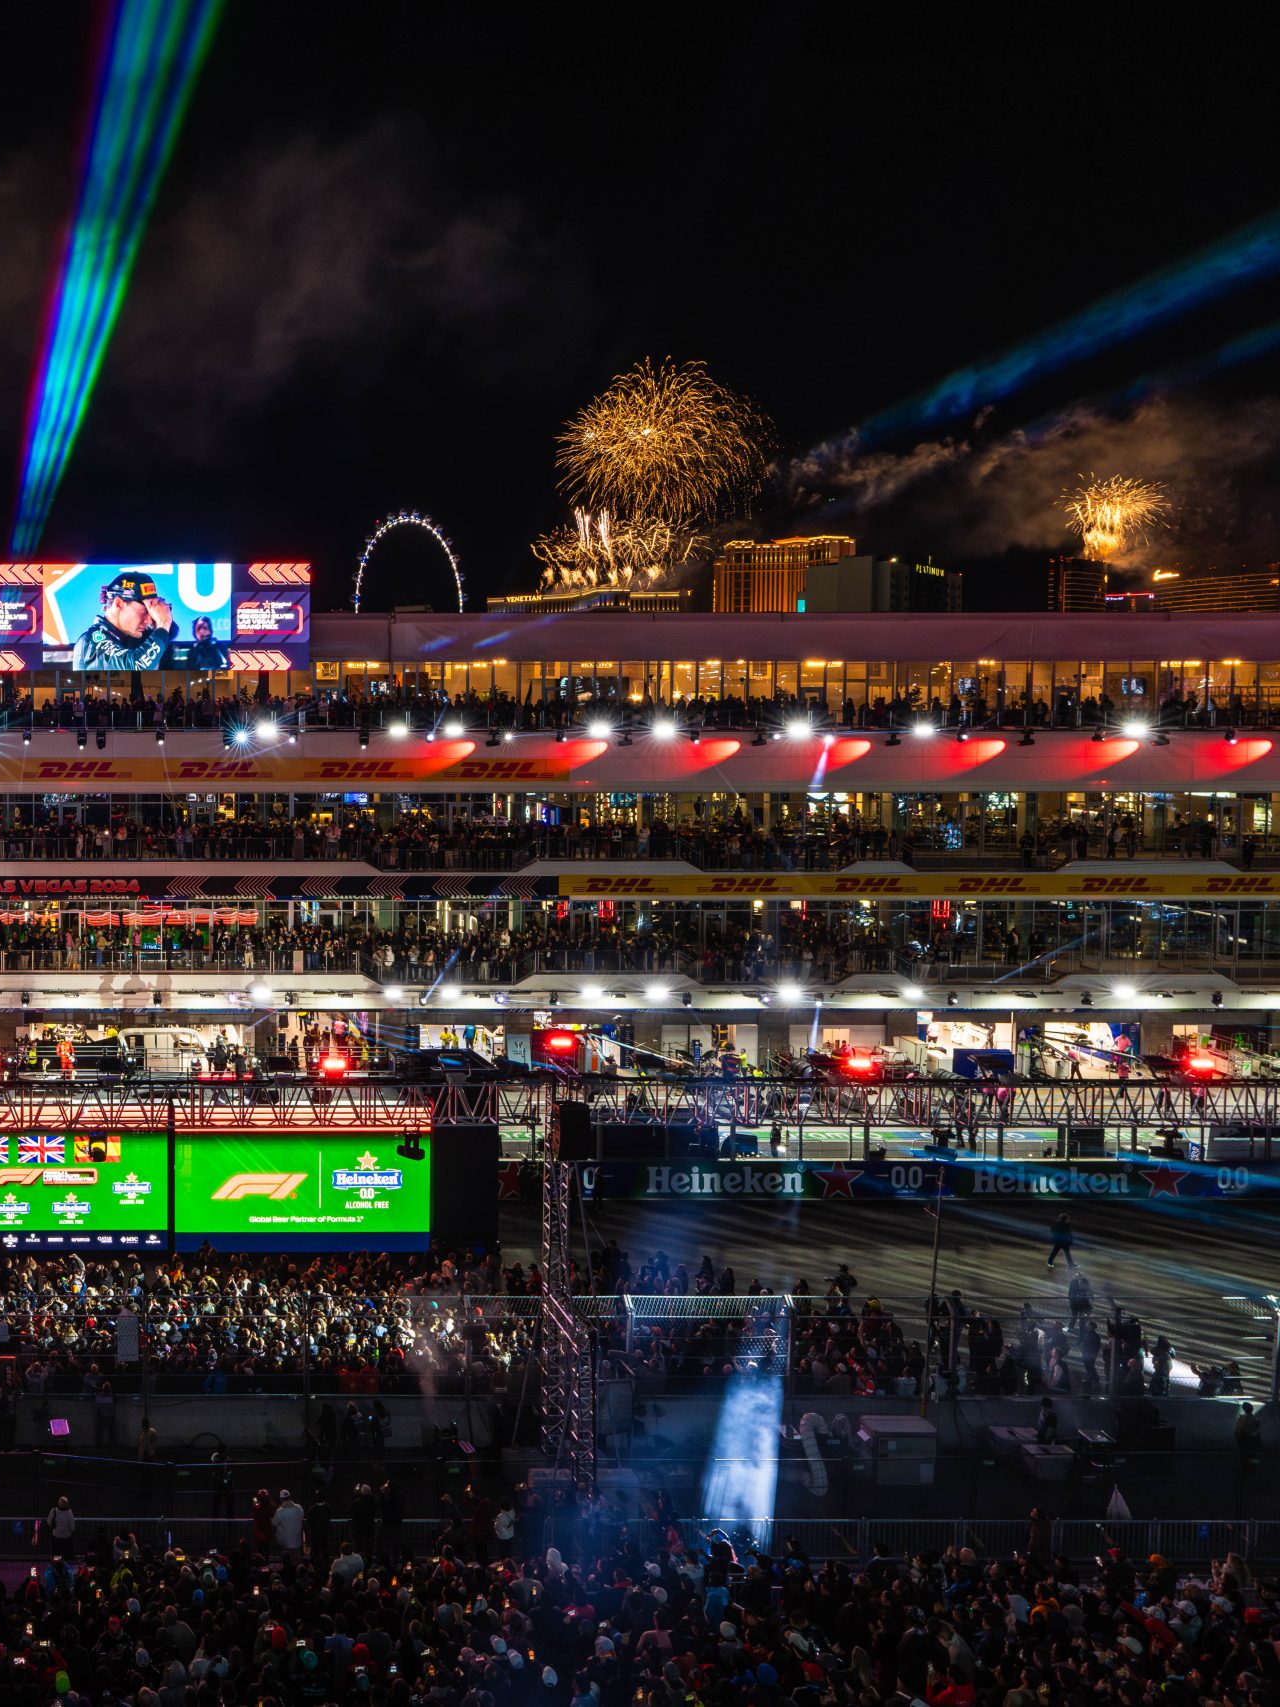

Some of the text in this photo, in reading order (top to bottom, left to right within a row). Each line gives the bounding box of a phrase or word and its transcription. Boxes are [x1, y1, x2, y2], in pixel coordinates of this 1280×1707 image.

[122, 579, 135, 589] 1ST
[38, 762, 119, 778] DHL
[178, 762, 258, 778] DHL
[319, 762, 398, 778] DHL
[459, 762, 538, 778] DHL
[18, 879, 87, 893] VEGAS
[89, 879, 140, 893] 2024
[586, 878, 656, 892] DHL
[710, 878, 780, 892] DHL
[834, 878, 904, 892] DHL
[957, 878, 1026, 892] DHL
[1080, 877, 1149, 892] DHL
[1205, 877, 1275, 892] DHL
[890, 1165, 923, 1189] 0.0
[1217, 1166, 1248, 1189] 0.0
[210, 1174, 308, 1199] F1
